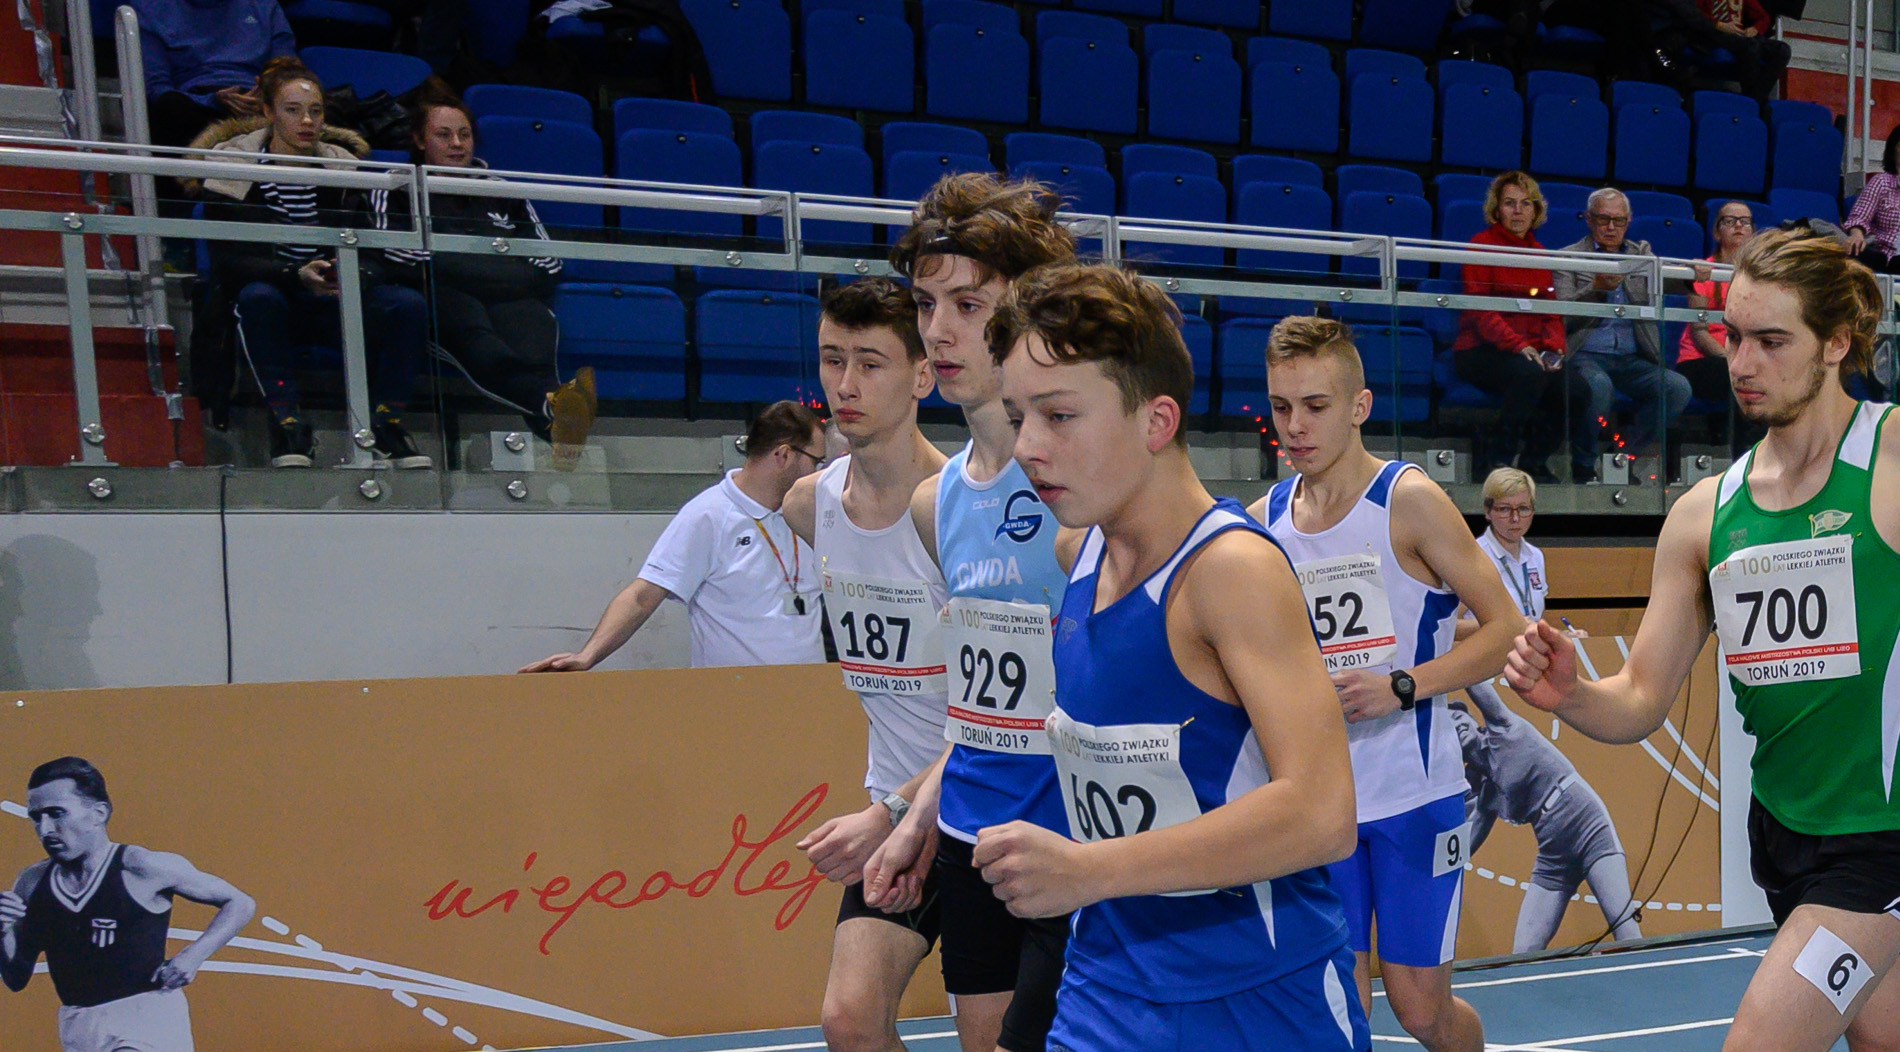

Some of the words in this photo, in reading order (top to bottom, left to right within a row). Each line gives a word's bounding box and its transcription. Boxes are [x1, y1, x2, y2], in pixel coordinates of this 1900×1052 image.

[1005, 521, 1030, 529] GWDA
[1740, 556, 1771, 576] 100
[1773, 551, 1812, 562] POLSKIEGO
[1814, 547, 1846, 558] ZWIĄZKU
[1787, 560, 1813, 571] LEKKIEJ
[1815, 557, 1846, 567] ATLETYKI
[956, 556, 1023, 590] GWDA
[1298, 570, 1316, 586] 00
[840, 581, 865, 599] 100
[959, 608, 980, 629] 100
[1315, 591, 1369, 641] 52
[1736, 584, 1828, 647] 700
[840, 610, 910, 663] 187
[1341, 652, 1370, 667] 2019
[960, 644, 1027, 711] 929
[1747, 660, 1789, 681] TORUŃ
[1793, 661, 1825, 676] 2019
[850, 675, 889, 690] TORUŃ
[892, 680, 921, 691] 2019
[961, 725, 992, 745] TORUŃ
[996, 733, 1029, 749] 2019
[1078, 737, 1120, 751] POLSKIEGO
[1123, 738, 1169, 752] ZWIĄZKU
[1094, 753, 1124, 764] LEKKIEJ
[1126, 752, 1170, 764] ATLETYKI
[1071, 773, 1157, 840] 602
[424, 782, 831, 956] niepodleg
